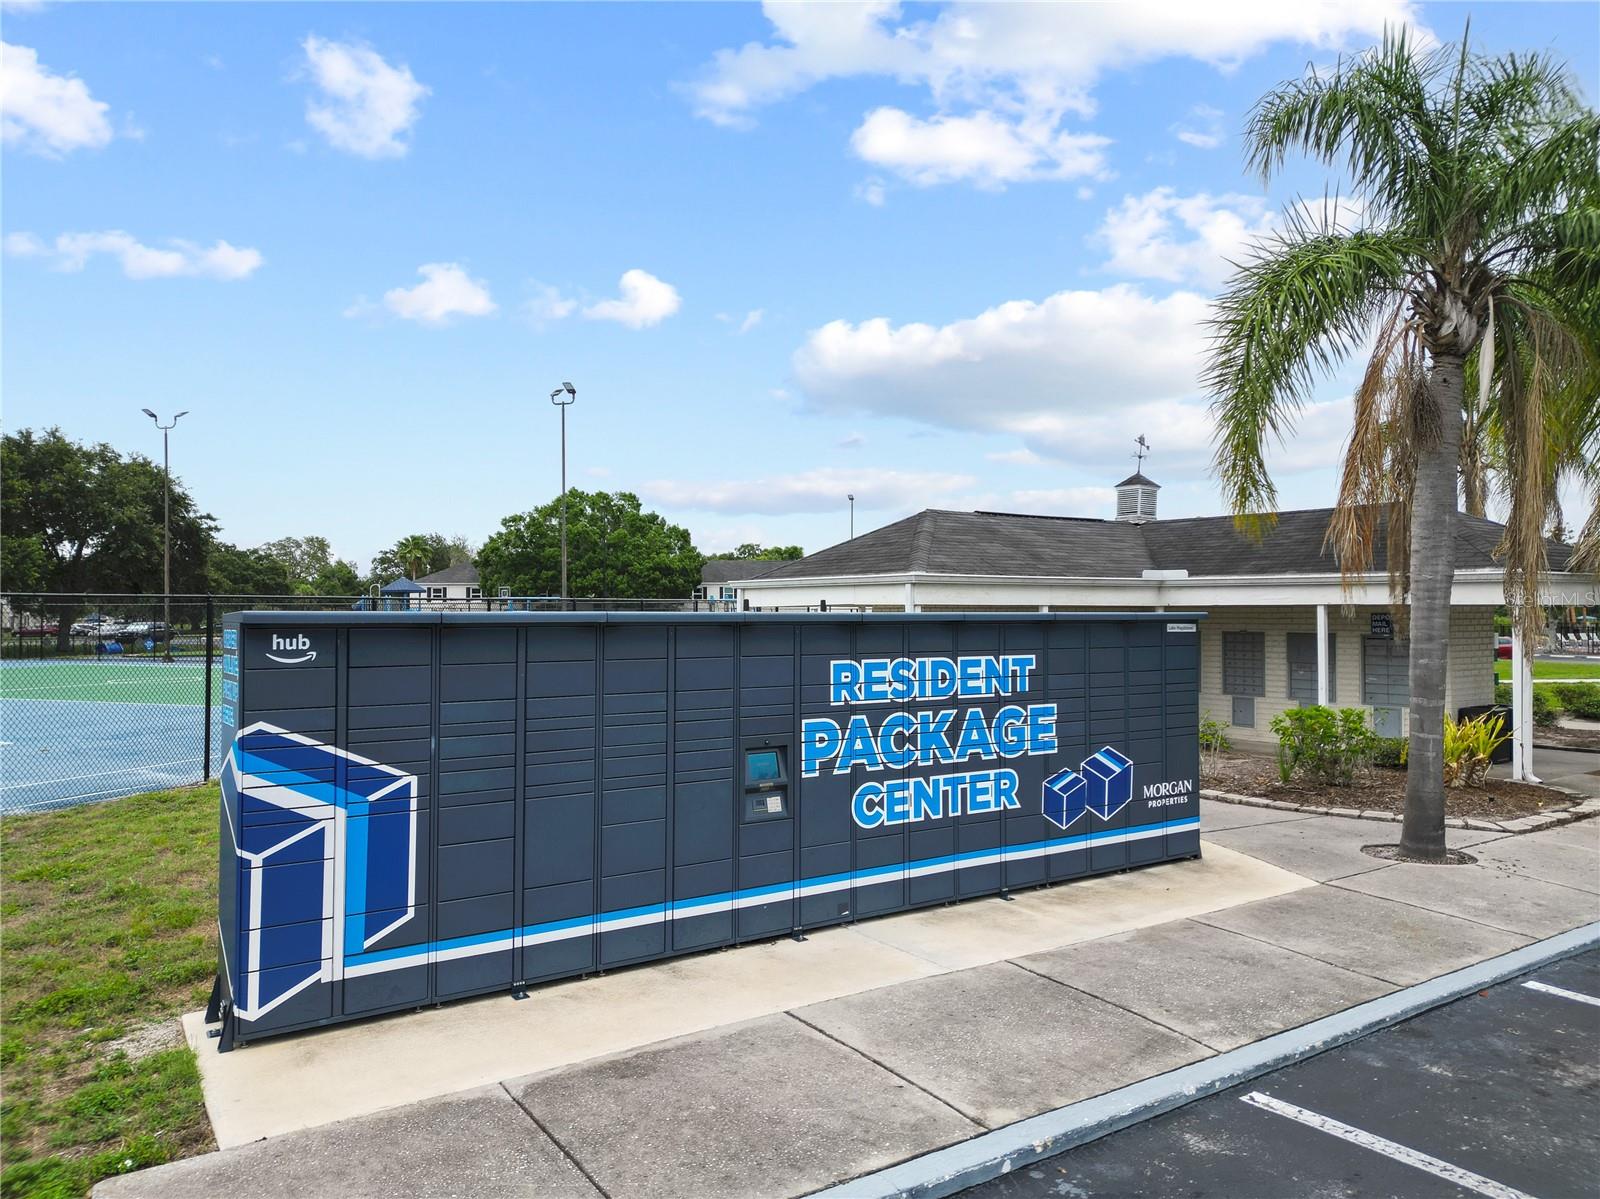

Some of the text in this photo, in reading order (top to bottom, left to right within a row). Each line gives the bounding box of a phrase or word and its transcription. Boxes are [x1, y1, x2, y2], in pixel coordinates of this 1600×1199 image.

[272, 634, 310, 650] hub
[830, 655, 1036, 705] RESIDENT
[801, 703, 1058, 778] PACKAGE
[851, 768, 1021, 829] CENTER
[1144, 779, 1192, 799] MORGAN
[1148, 796, 1188, 808] PROPERTIES
